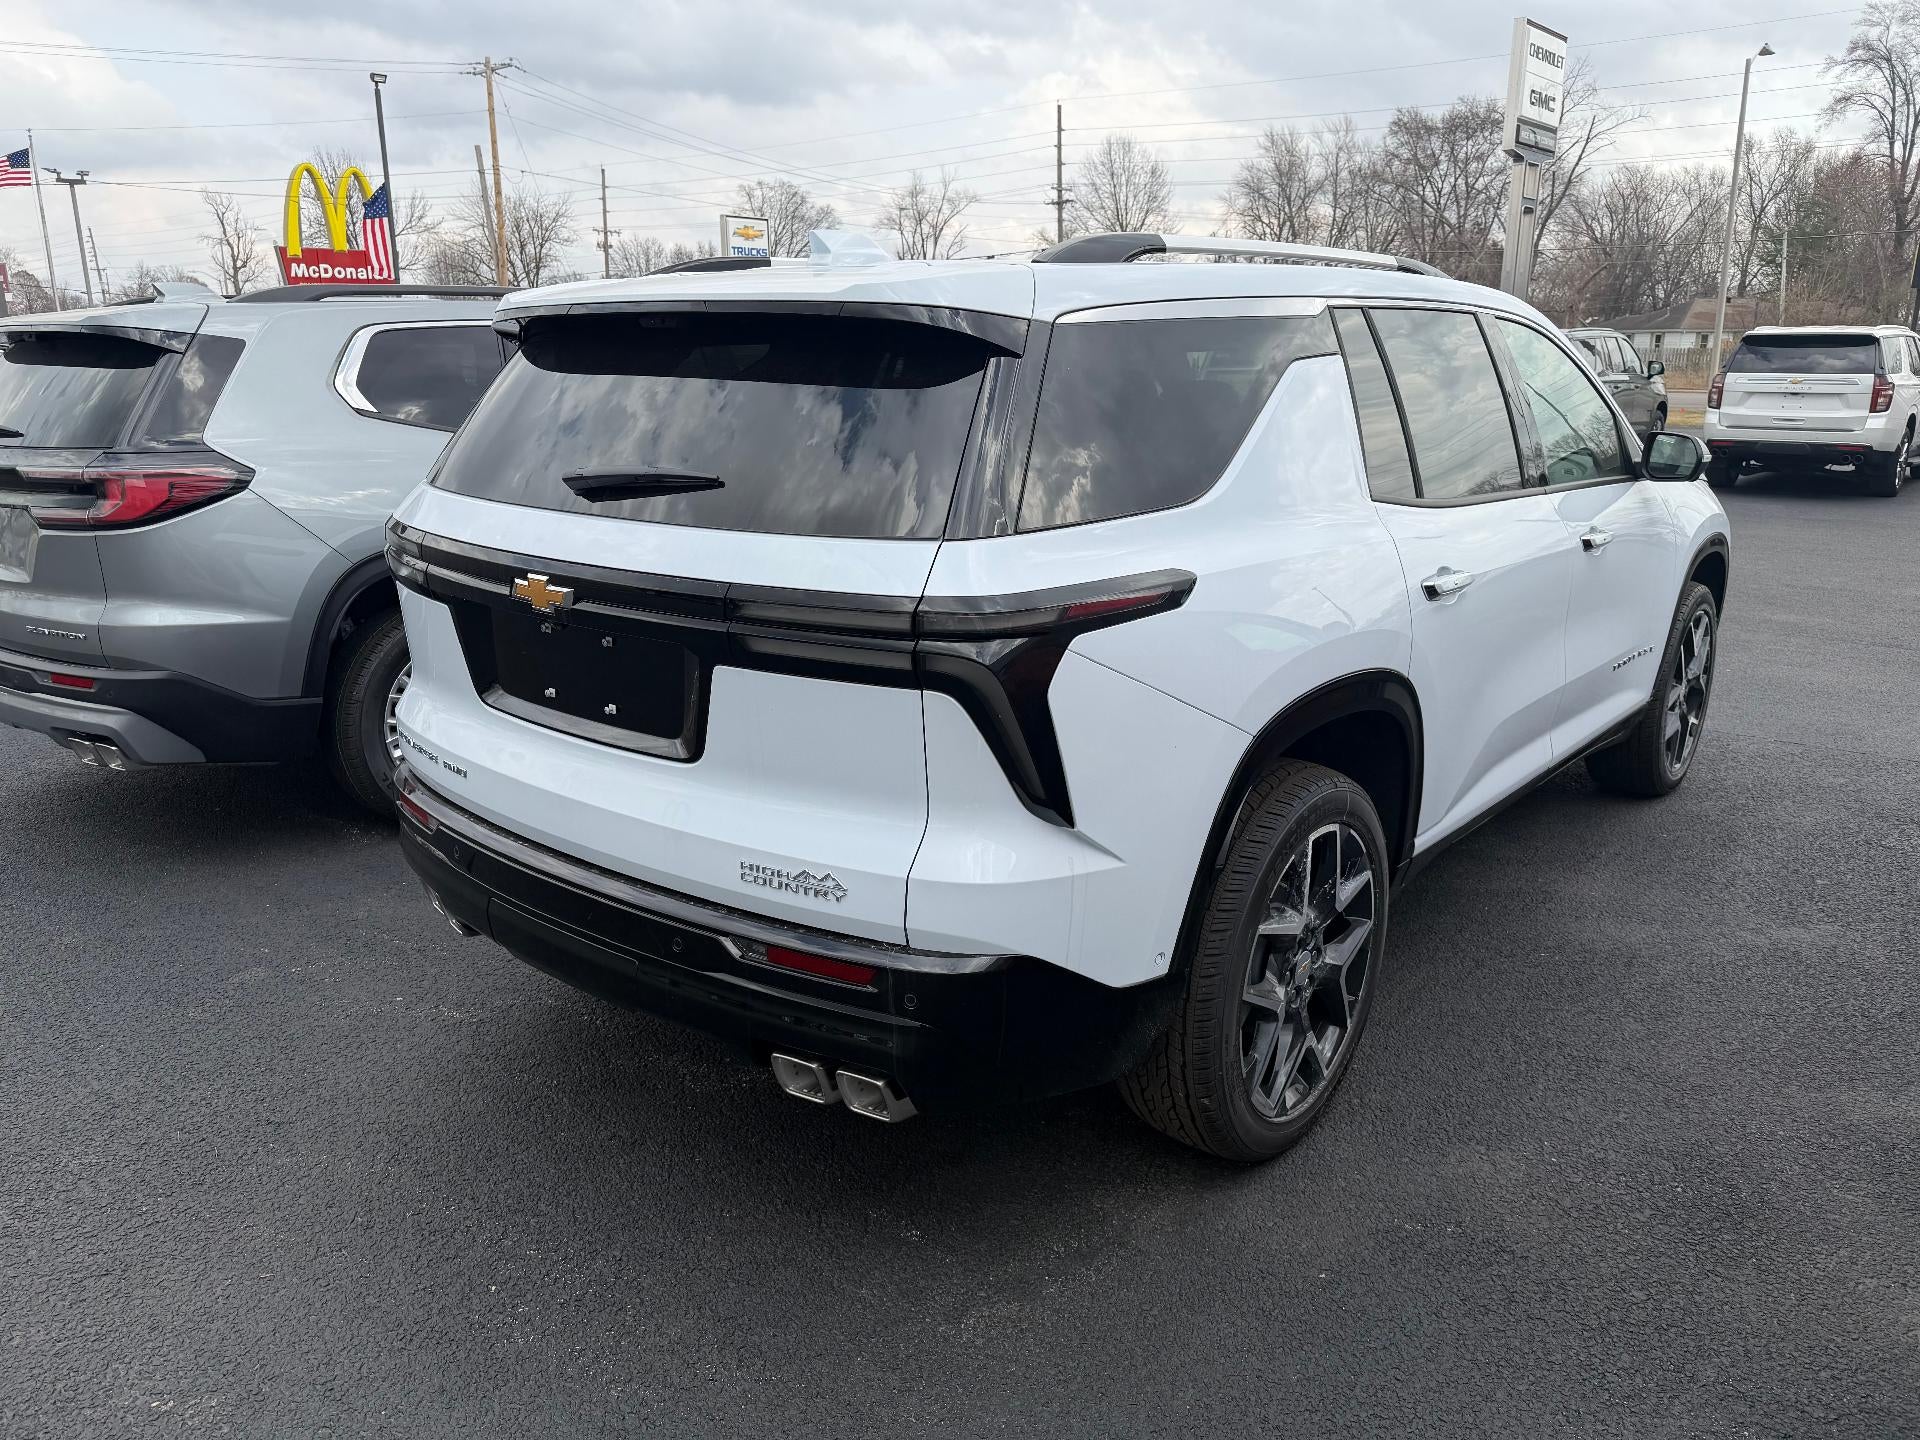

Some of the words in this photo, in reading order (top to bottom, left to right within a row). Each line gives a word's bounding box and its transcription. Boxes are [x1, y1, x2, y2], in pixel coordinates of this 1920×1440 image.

[1529, 42, 1566, 70] CHEVROLET
[1529, 89, 1556, 113] GMC
[731, 246, 768, 257] TRUCKS
[290, 262, 394, 280] McDonal
[740, 860, 792, 881] HIGH
[740, 872, 848, 902] COUNTRY
